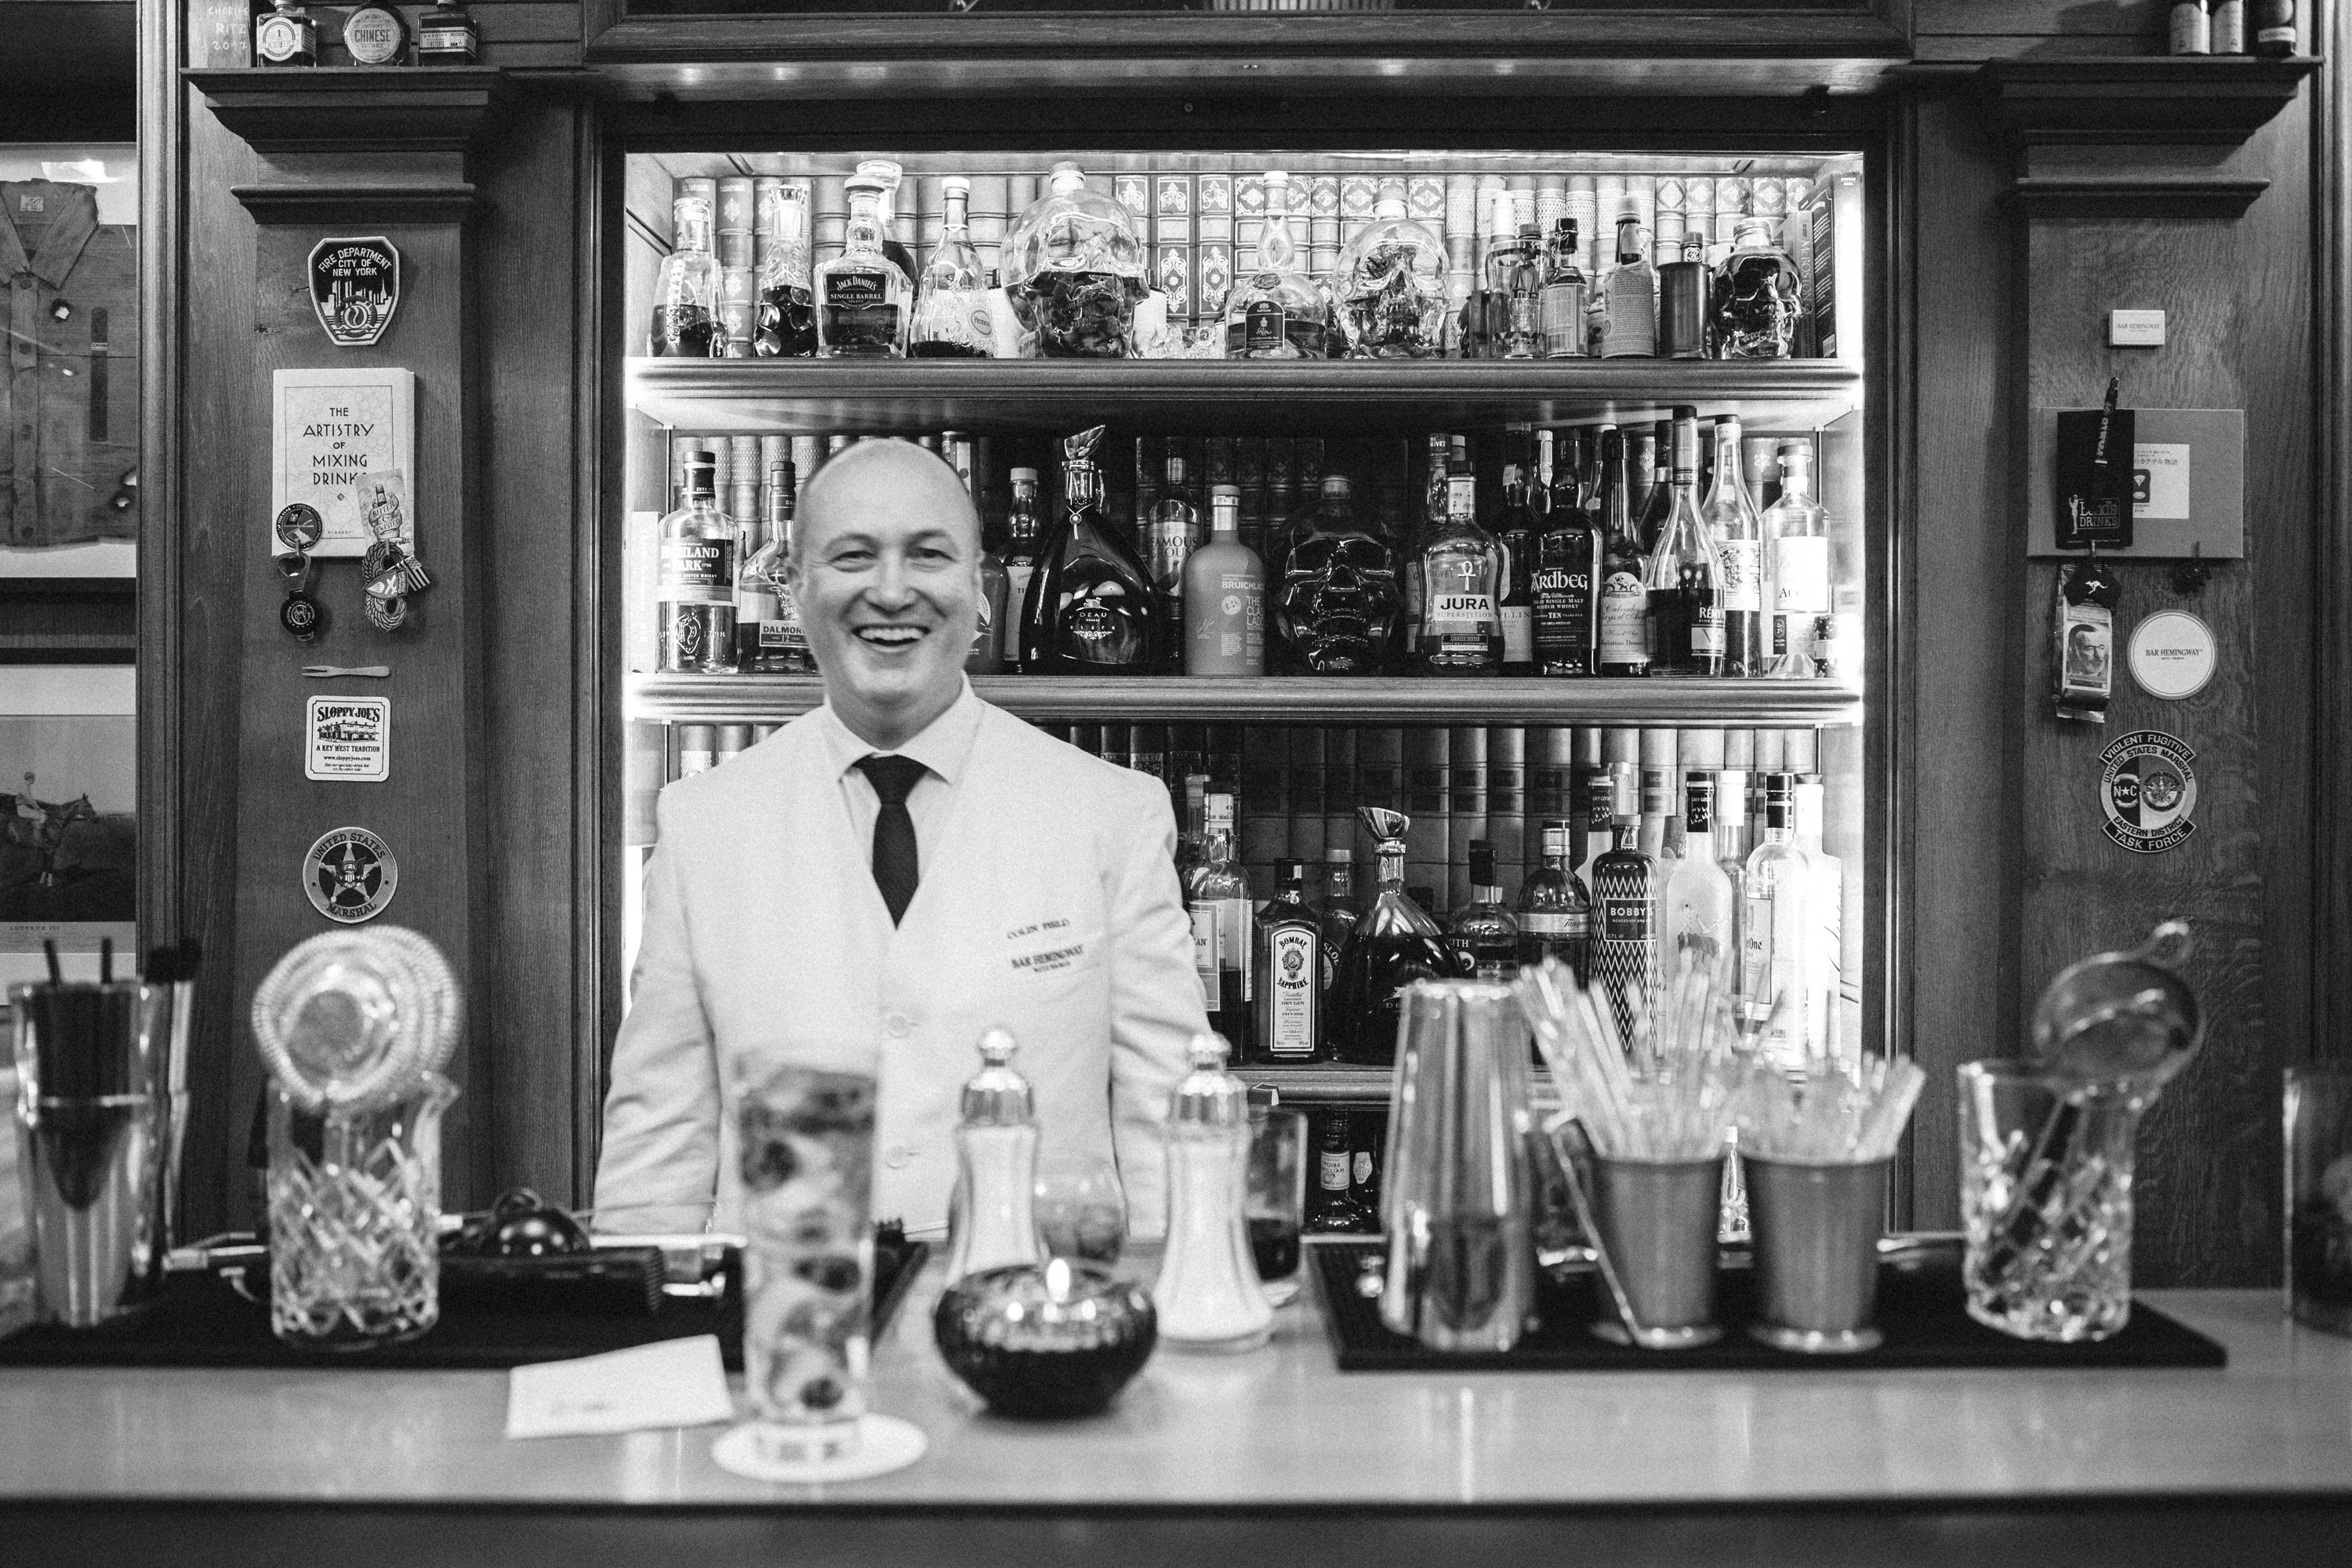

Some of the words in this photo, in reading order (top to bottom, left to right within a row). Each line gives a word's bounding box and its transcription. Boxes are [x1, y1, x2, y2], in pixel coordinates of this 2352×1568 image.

[208, 5, 248, 16] CHARLES
[216, 22, 248, 35] RITZ
[354, 29, 391, 42] CHINESE
[212, 41, 248, 51] 2017
[318, 253, 338, 273] FIRE
[337, 247, 393, 270] DEPARTMENT
[338, 259, 358, 267] CITY
[361, 259, 372, 267] OF
[332, 268, 351, 277] NEW
[355, 267, 377, 276] YORK
[1801, 256, 1813, 301] BOSTON
[836, 278, 853, 292] JACK
[852, 275, 878, 292] DANIEL'S
[329, 407, 349, 417] THE
[303, 423, 375, 437] ARTISTRY
[332, 441, 347, 450] OF
[313, 454, 368, 467] MIXING
[313, 472, 367, 485] DRINK
[372, 500, 395, 517] BITTER
[376, 517, 400, 533] TWISTED
[2079, 516, 2118, 527] DRINKS
[1150, 535, 1199, 548] FAMOUS
[1149, 547, 1195, 558] GROUS
[671, 559, 703, 572] PARK
[1246, 596, 1261, 607] THE
[1440, 597, 1490, 610] JURA
[782, 634, 790, 643] 12
[317, 706, 355, 722] SLOPPY
[354, 707, 380, 723] JOE'S
[2104, 735, 2143, 760] VIOLENT
[2147, 734, 2191, 760] FUGITIVE
[2103, 756, 2125, 783] UNITED
[2126, 746, 2158, 758] STATES
[2160, 748, 2193, 782] MARSHAL
[2113, 815, 2148, 837] EASTERN
[2151, 815, 2186, 837] DISTRICT
[2113, 829, 2143, 849] TASK
[2148, 829, 2187, 850] FORCE
[313, 833, 347, 861] UNITED
[350, 832, 386, 858] STATES
[325, 902, 378, 918] MARSHAL
[1279, 936, 1308, 949] BOMBAY
[1276, 976, 1309, 989] SAPPHIRE
